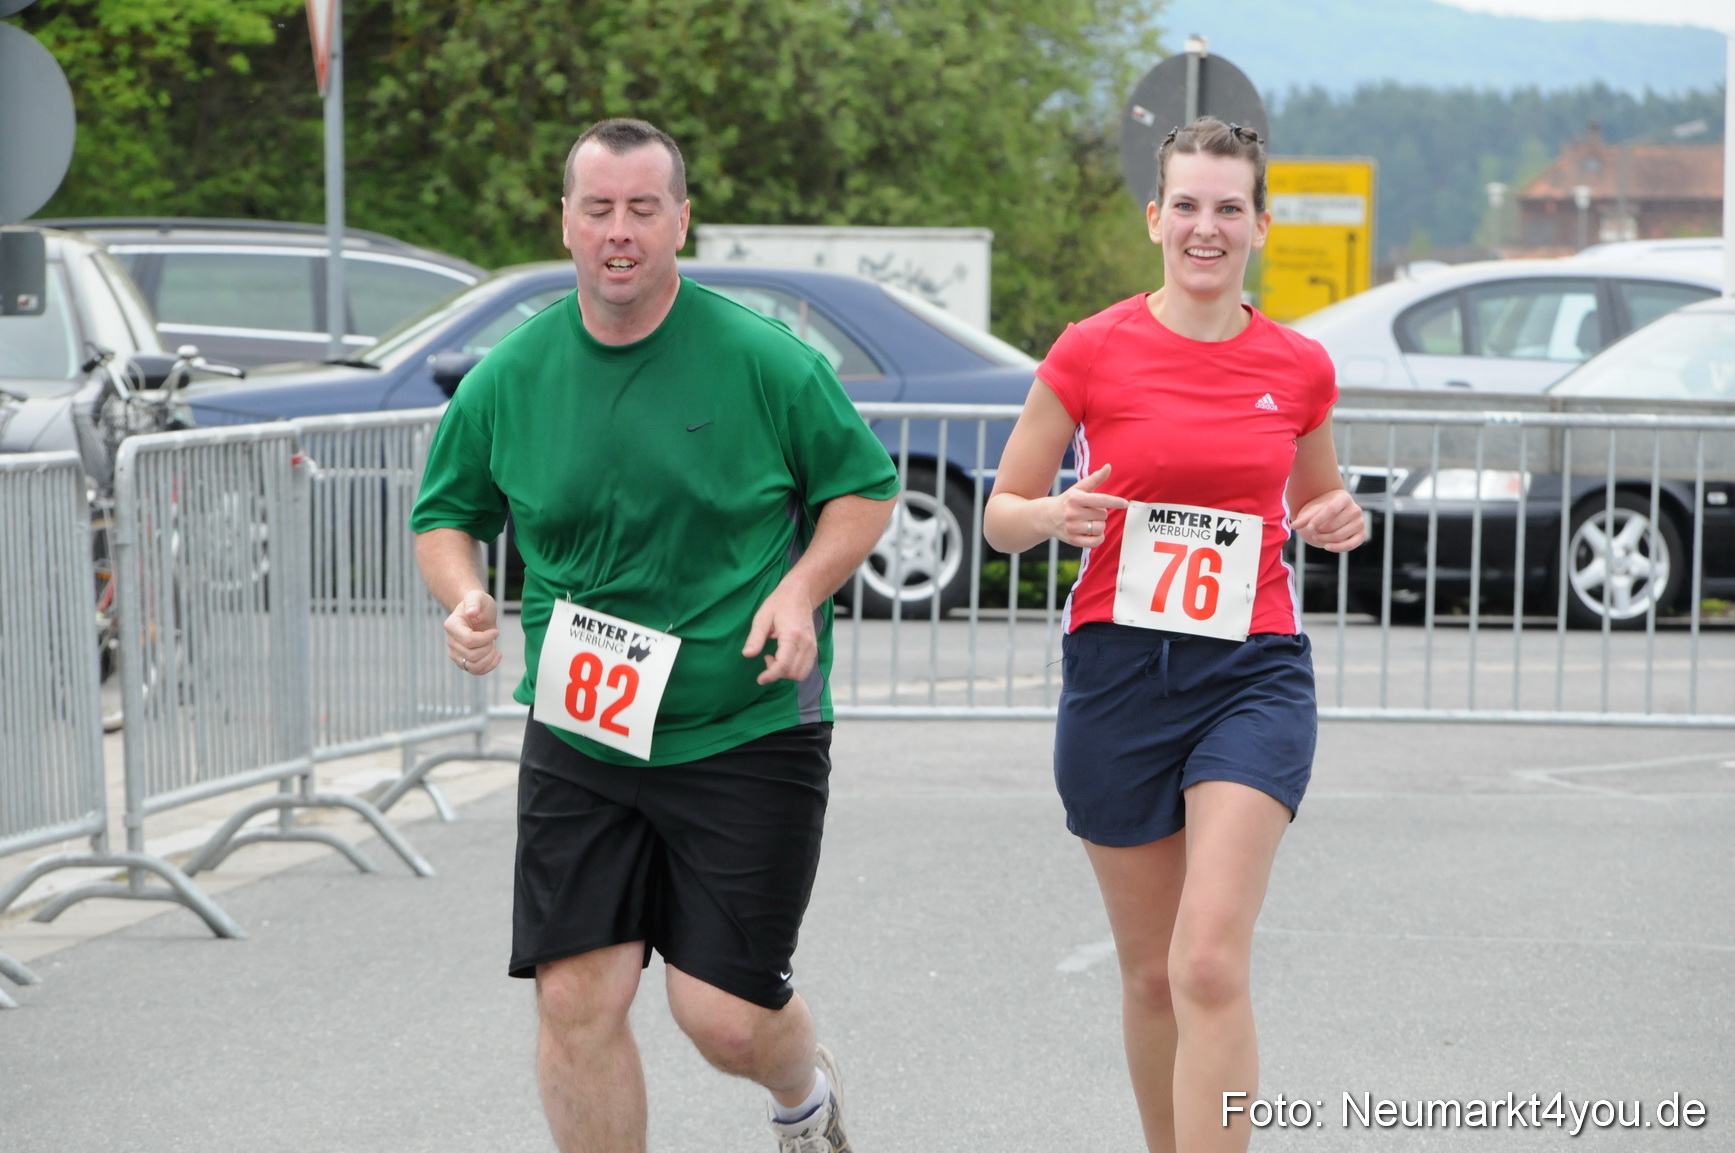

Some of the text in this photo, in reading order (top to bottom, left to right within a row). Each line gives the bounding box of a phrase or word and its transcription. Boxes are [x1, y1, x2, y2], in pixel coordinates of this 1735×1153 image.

[1148, 523, 1211, 541] WERBUNG
[1149, 509, 1212, 529] MEYER
[1150, 541, 1222, 621] 76
[569, 627, 624, 654] WERBUNG
[571, 613, 628, 643] MEYER
[564, 651, 640, 738] 82
